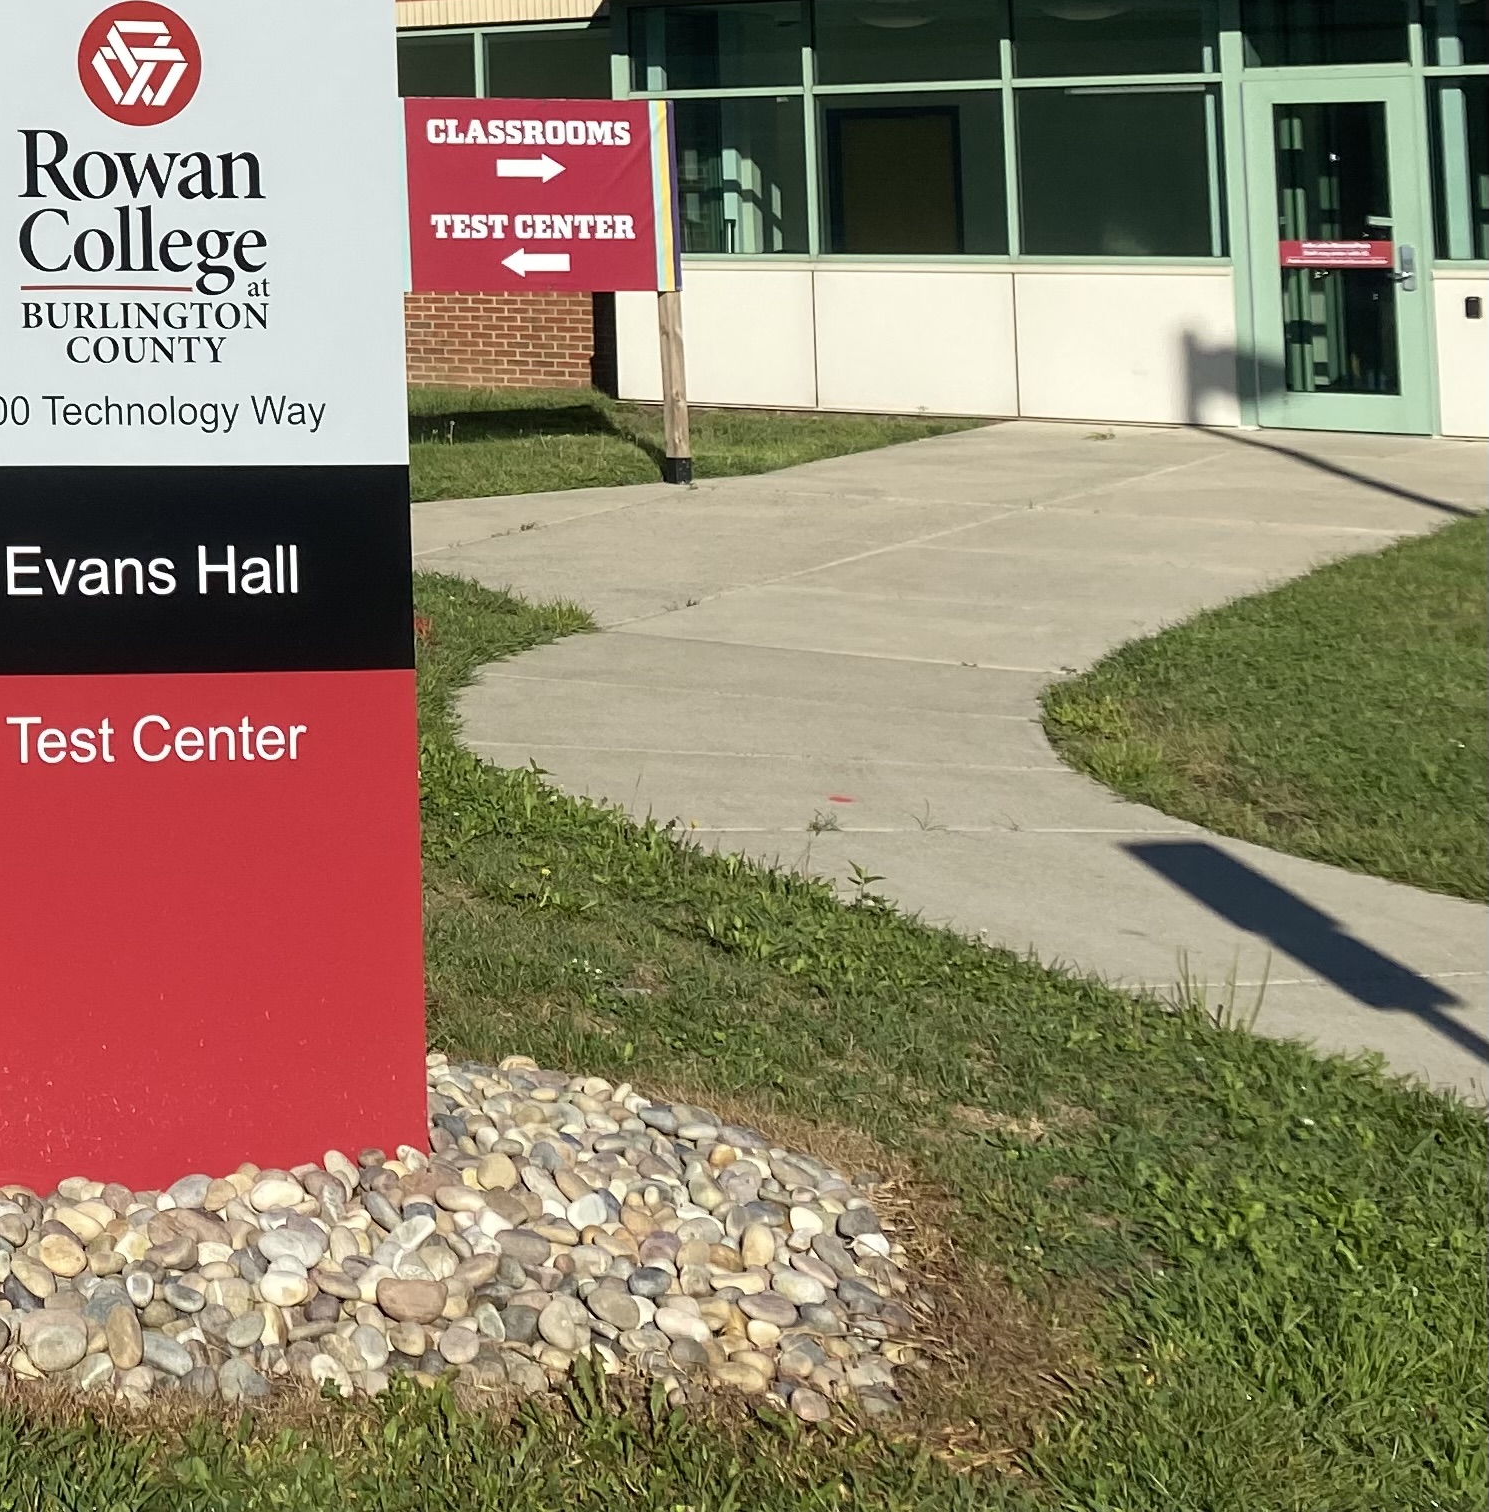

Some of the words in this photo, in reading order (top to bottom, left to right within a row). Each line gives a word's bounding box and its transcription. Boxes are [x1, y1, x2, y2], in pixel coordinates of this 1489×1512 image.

[426, 119, 631, 146] CLASSROOMS
[17, 129, 266, 201] Rowan
[430, 214, 509, 239] TEST
[514, 214, 636, 240] CENTER
[18, 205, 268, 297] College
[247, 277, 270, 298] at
[21, 301, 269, 331] BURLINGTON
[65, 336, 227, 364] COUNTY
[42, 395, 239, 434] Technology
[251, 395, 327, 433] Way
[6, 545, 176, 596] Evans
[198, 544, 300, 595] Hall
[6, 716, 115, 764] Test
[132, 714, 307, 763] Center
